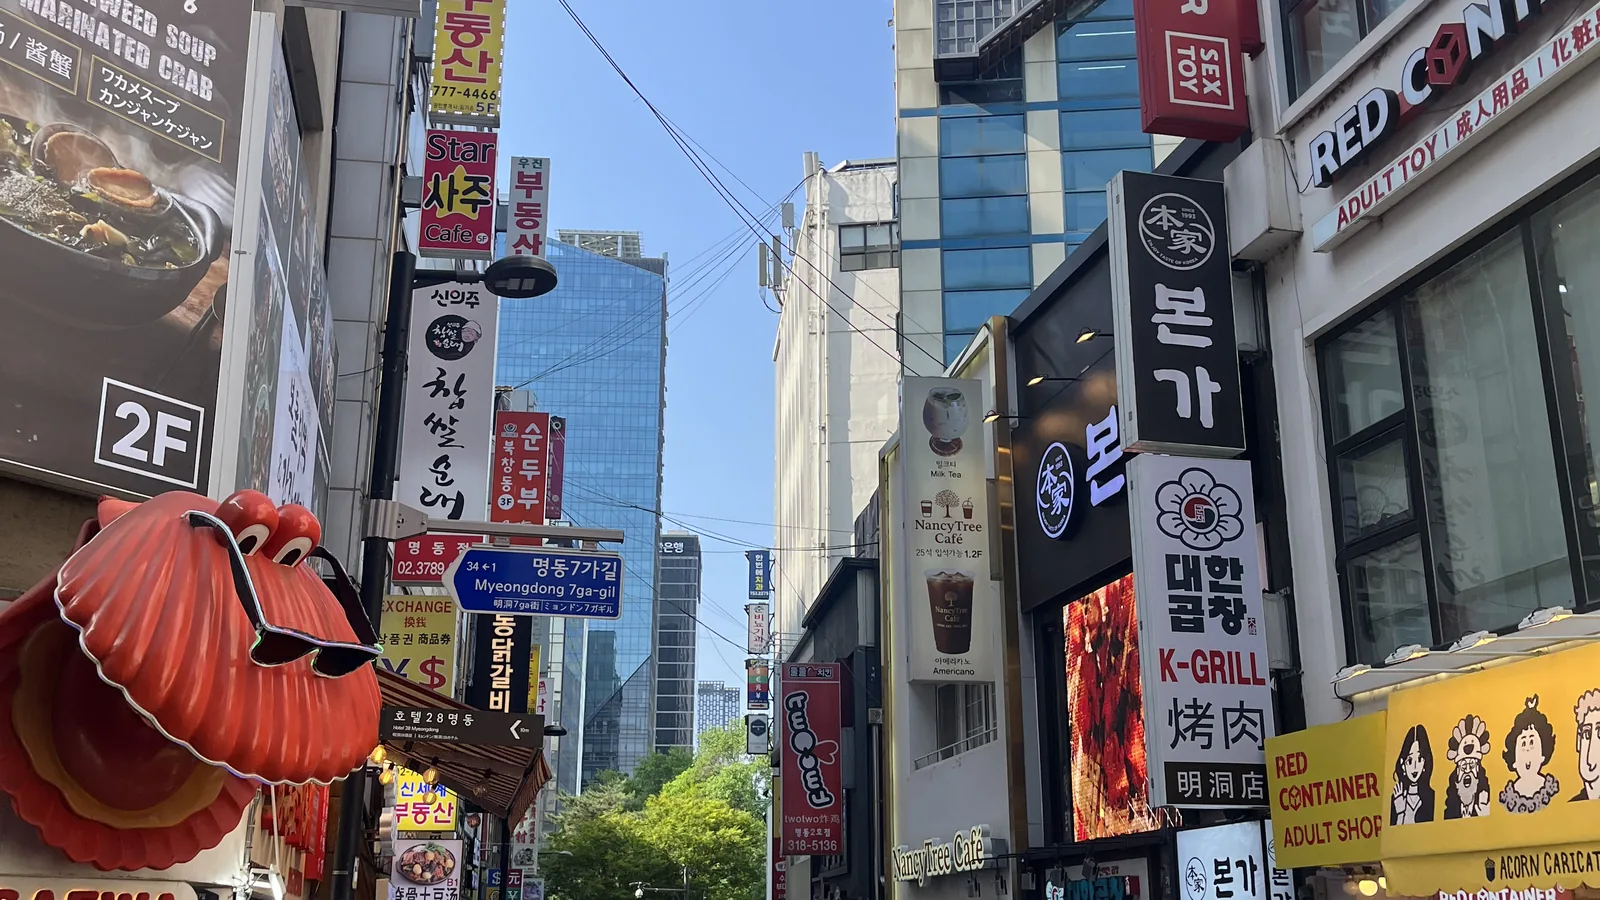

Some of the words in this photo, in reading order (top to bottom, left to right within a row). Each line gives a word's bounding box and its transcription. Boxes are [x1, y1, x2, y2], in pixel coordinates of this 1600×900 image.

[166, 23, 216, 68] SOUP
[158, 53, 213, 102] CRAB
[1177, 45, 1199, 94] TOY
[1199, 47, 1223, 97] SEX
[101, 66, 181, 115] ワカメスープ
[432, 85, 498, 101] 777-4466
[1456, 67, 1529, 141] 成人用品
[98, 87, 213, 150] カンジャンケジャン
[476, 102, 497, 114] 5F
[426, 133, 495, 163] Star
[1309, 87, 1390, 187] RED
[518, 158, 543, 170] 우진
[423, 173, 491, 215] 사주
[1337, 167, 1396, 233] ADULT
[1397, 134, 1438, 182] TOY
[512, 172, 544, 256] 부동산
[425, 224, 473, 247] Cafe
[431, 289, 480, 309] 신의주
[1151, 283, 1222, 428] 본가
[112, 401, 192, 467] 2F
[501, 440, 516, 492] 북창동
[517, 422, 543, 510] 순두부
[930, 470, 946, 478] Milk
[947, 471, 962, 479] Tea
[499, 496, 513, 507] 3F
[914, 519, 983, 535] NancyTree
[934, 532, 964, 544] Café
[397, 561, 453, 576] 02.3789
[466, 561, 479, 572] 34
[491, 562, 496, 573] 1
[532, 557, 617, 581] 명동7가길
[1164, 553, 1244, 593] 대한
[474, 578, 565, 598] Myeongdong
[568, 583, 616, 600] 7ga-gil
[1168, 594, 1248, 636] 곱창
[418, 655, 446, 690] $
[932, 667, 975, 677] Americano
[934, 657, 972, 666] 아메리카노
[1159, 648, 1266, 686] K-GRILL
[1168, 697, 1264, 751] 烤肉
[1275, 751, 1308, 779] RED
[1177, 771, 1264, 800] 明洞店
[787, 840, 838, 851] 318-5136
[1284, 821, 1333, 848] ADULT
[892, 838, 953, 887] NancyTree
[953, 824, 985, 872] Café
[1500, 853, 1541, 881] ACORN
[447, 878, 459, 887] B1
[1213, 854, 1258, 899] 본가
